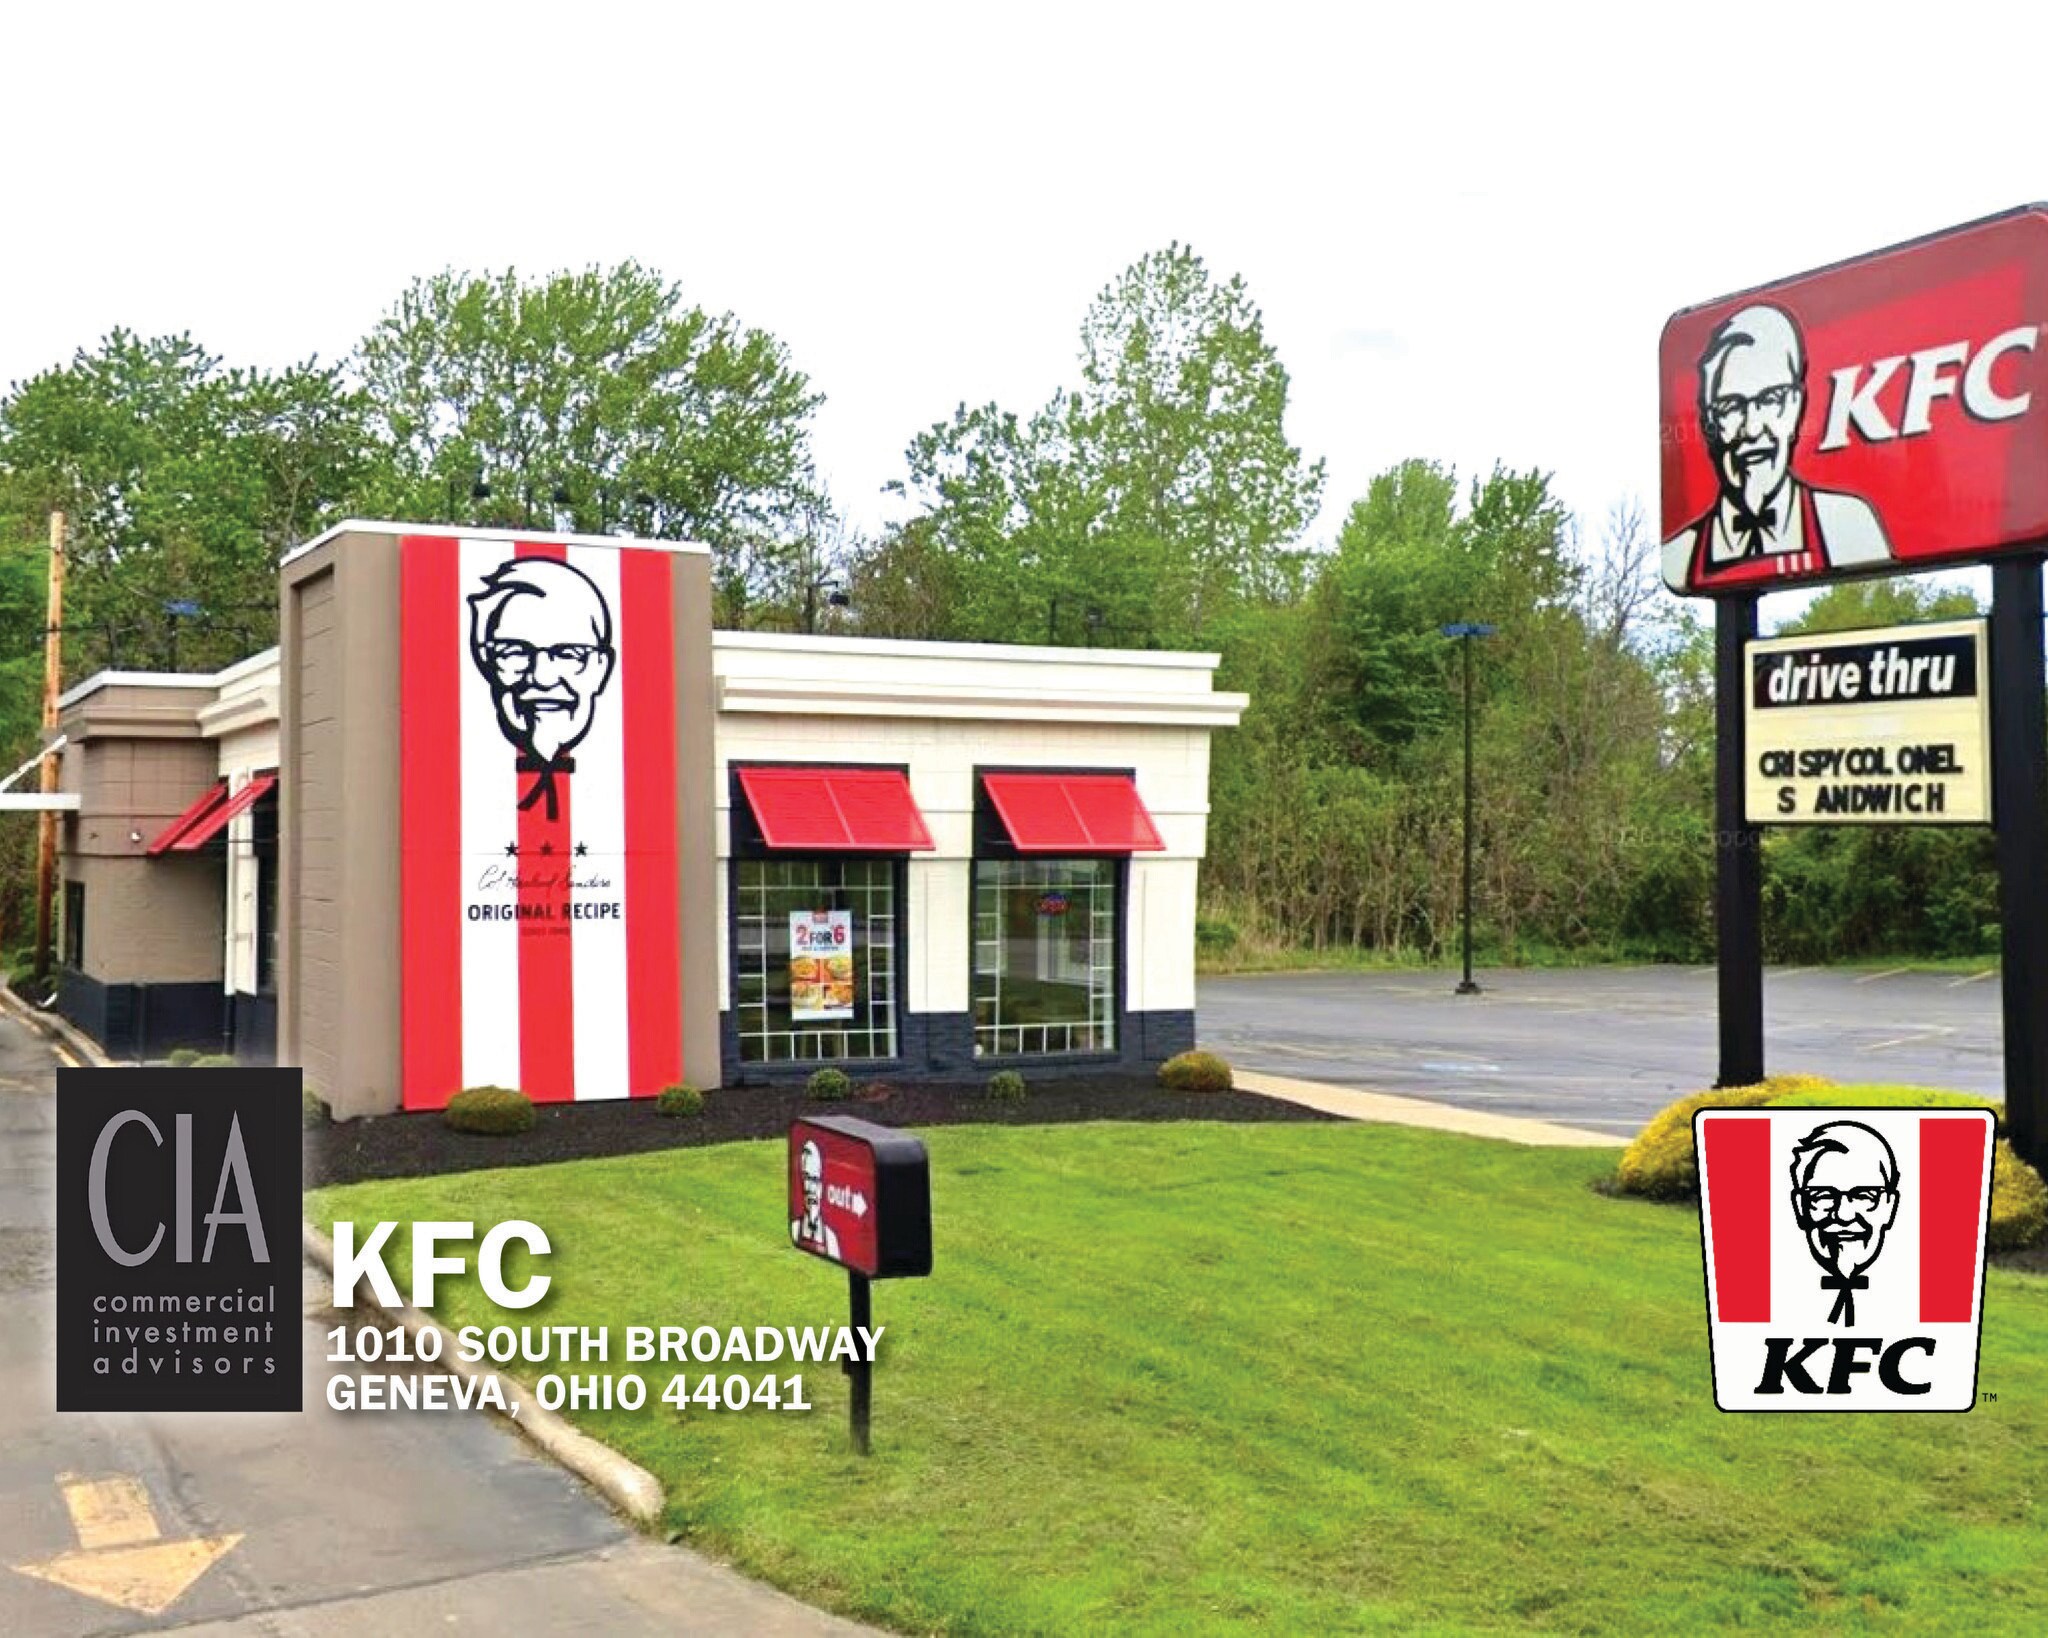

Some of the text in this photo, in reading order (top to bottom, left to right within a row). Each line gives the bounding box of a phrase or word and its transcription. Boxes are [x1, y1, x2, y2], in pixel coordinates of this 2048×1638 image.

[1818, 326, 2038, 452] KFC
[1768, 647, 1955, 702] drive thru
[467, 903, 621, 921] ORIGINAL RECIPE
[796, 924, 809, 946] 2
[810, 930, 832, 945] FOR
[827, 1184, 851, 1211] out
